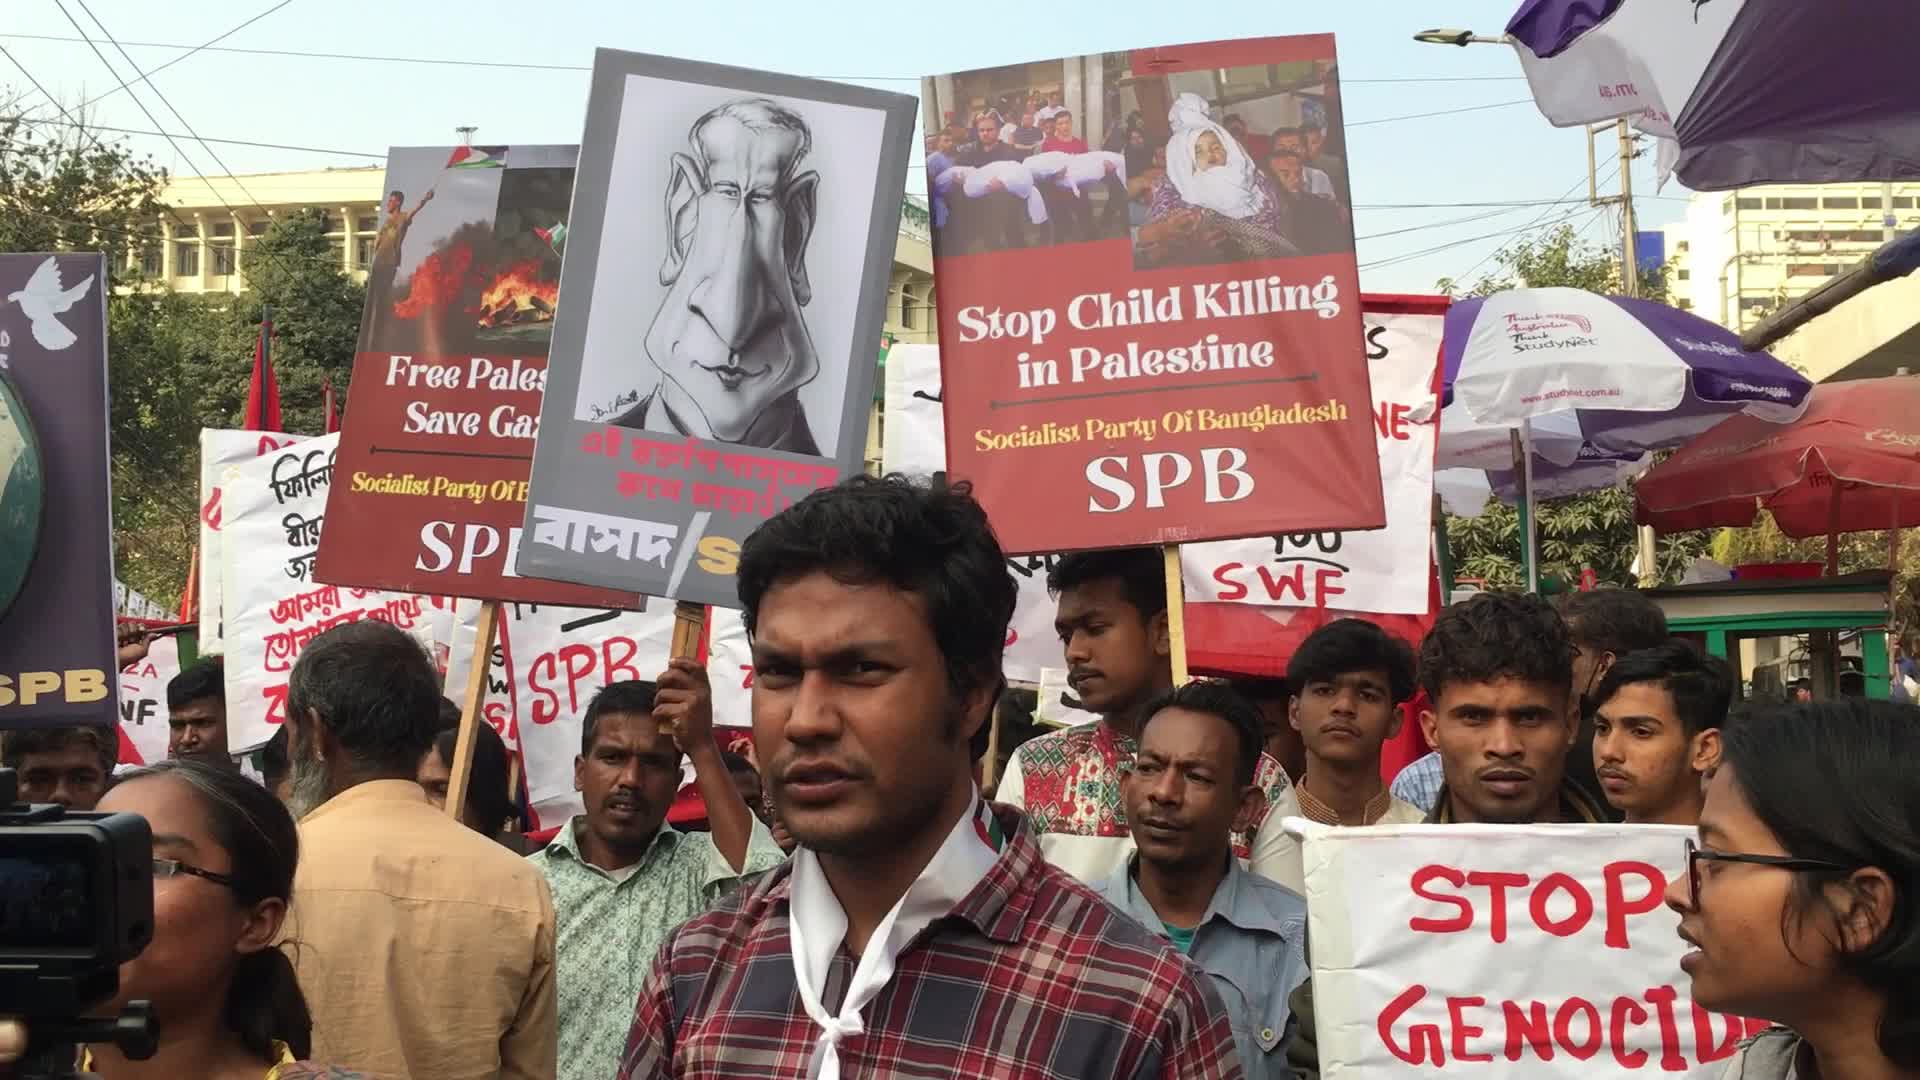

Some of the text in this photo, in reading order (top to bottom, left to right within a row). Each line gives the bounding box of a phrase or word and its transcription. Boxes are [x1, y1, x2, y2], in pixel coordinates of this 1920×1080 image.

[957, 275, 1341, 345] Stop Child Killing
[385, 356, 460, 388] Free
[1017, 334, 1275, 389] in Palestine
[404, 401, 481, 437] Save
[975, 399, 1348, 451] Socialist Party Of Bangladesh
[351, 471, 429, 496] Socialist
[433, 476, 487, 504] Party
[491, 480, 517, 501] Of
[1084, 446, 1256, 514] SPB
[1212, 562, 1346, 609] SWF
[1409, 860, 1669, 950] STOP
